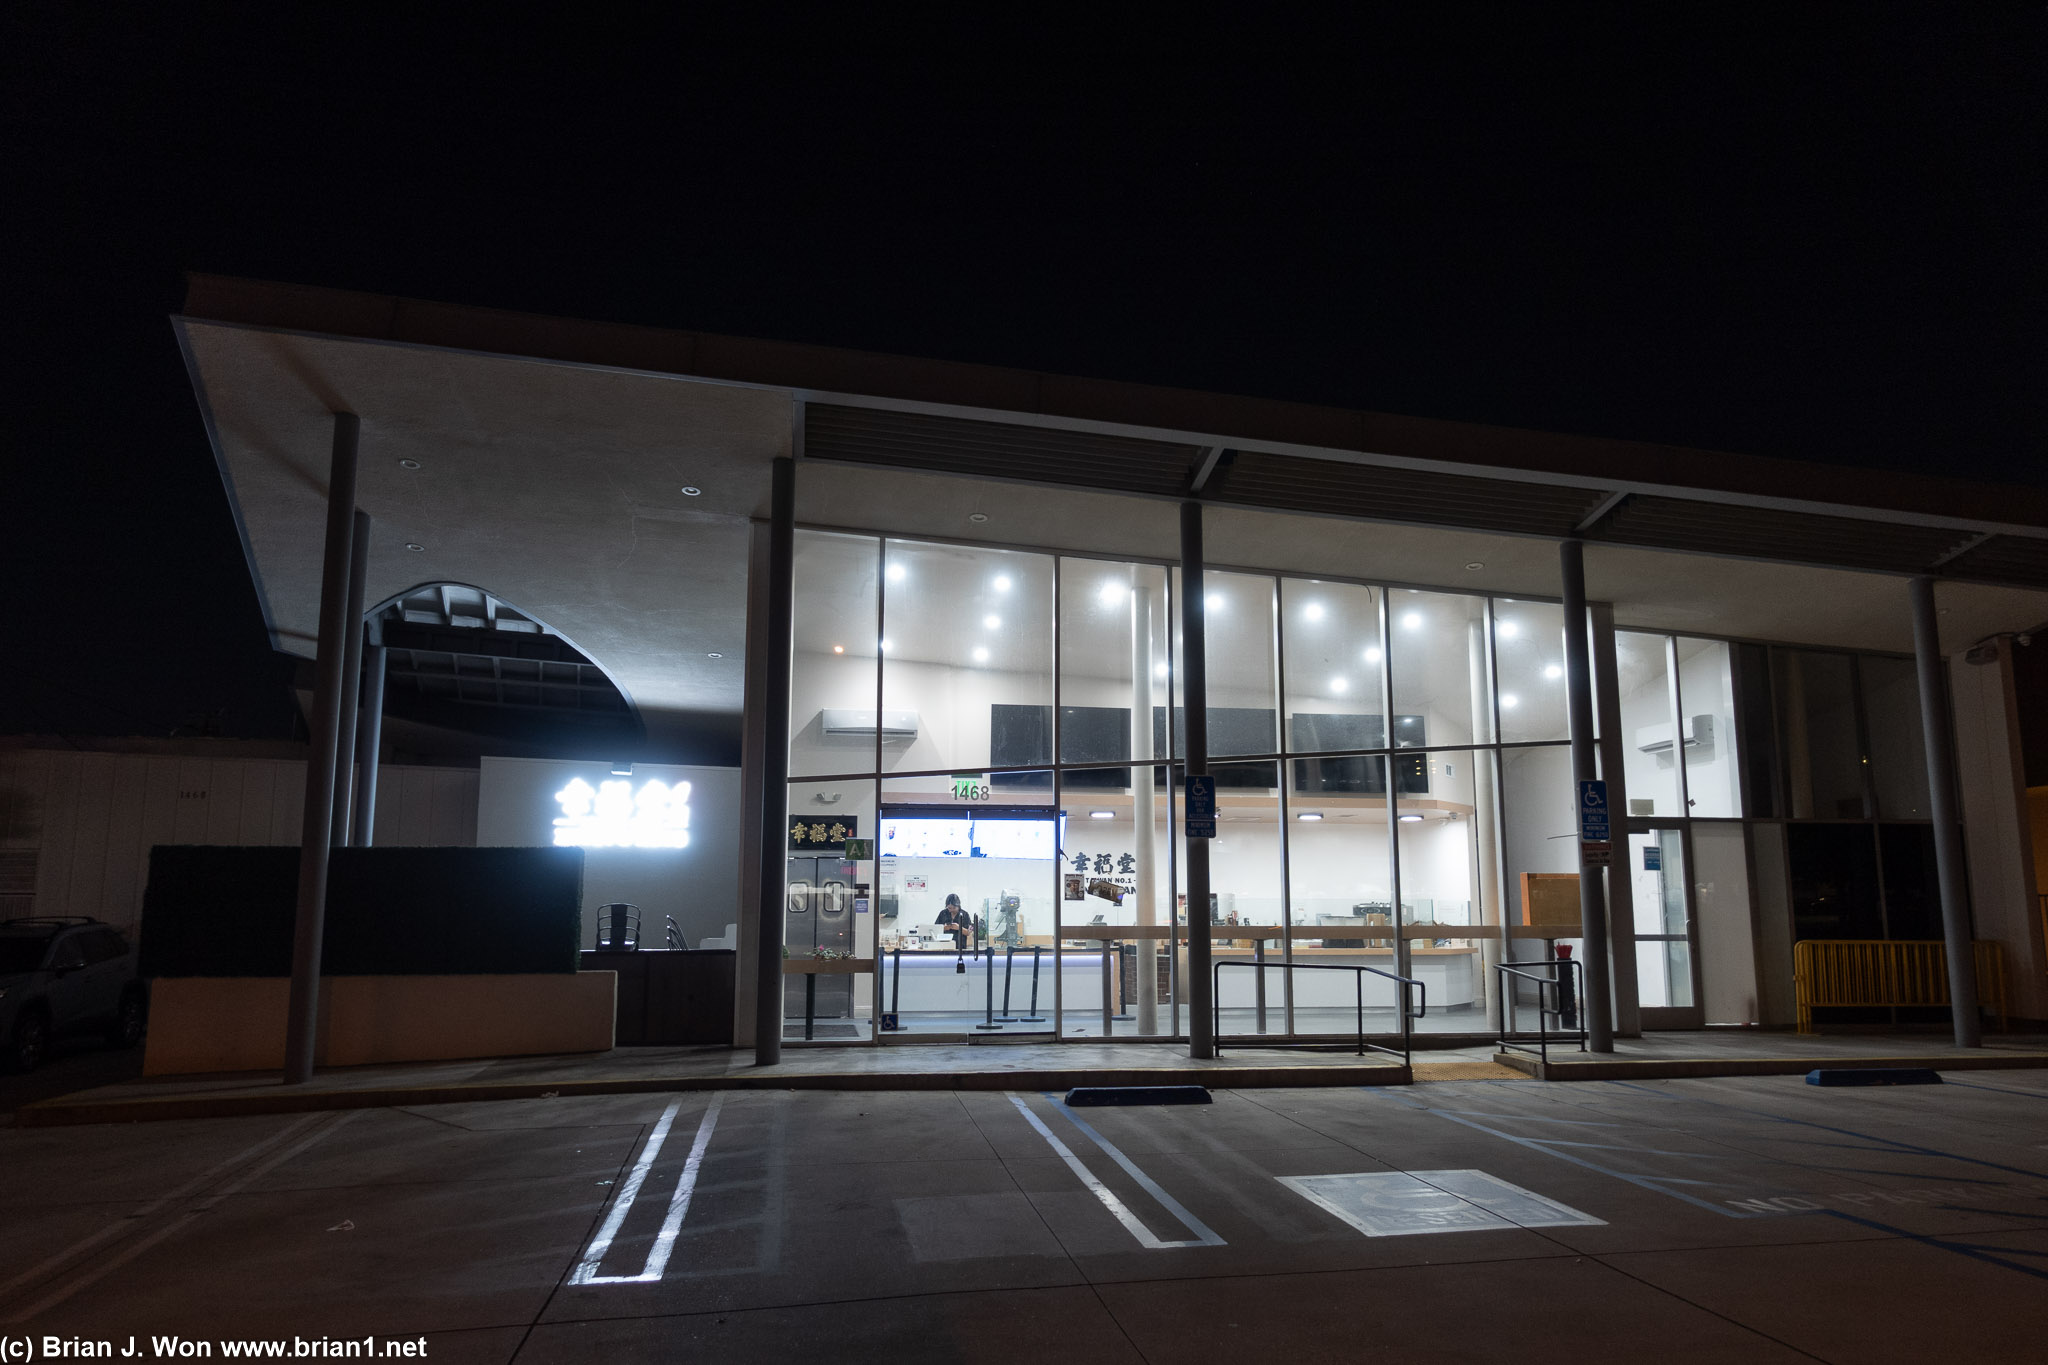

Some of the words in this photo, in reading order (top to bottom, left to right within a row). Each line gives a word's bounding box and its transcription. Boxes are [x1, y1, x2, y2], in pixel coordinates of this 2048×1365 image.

[951, 785, 990, 801] 1468
[1588, 815, 1602, 823] ONLY
[790, 822, 847, 844] 幸福堂
[1071, 852, 1136, 875] 幸福堂
[1725, 1196, 1825, 1213] NO
